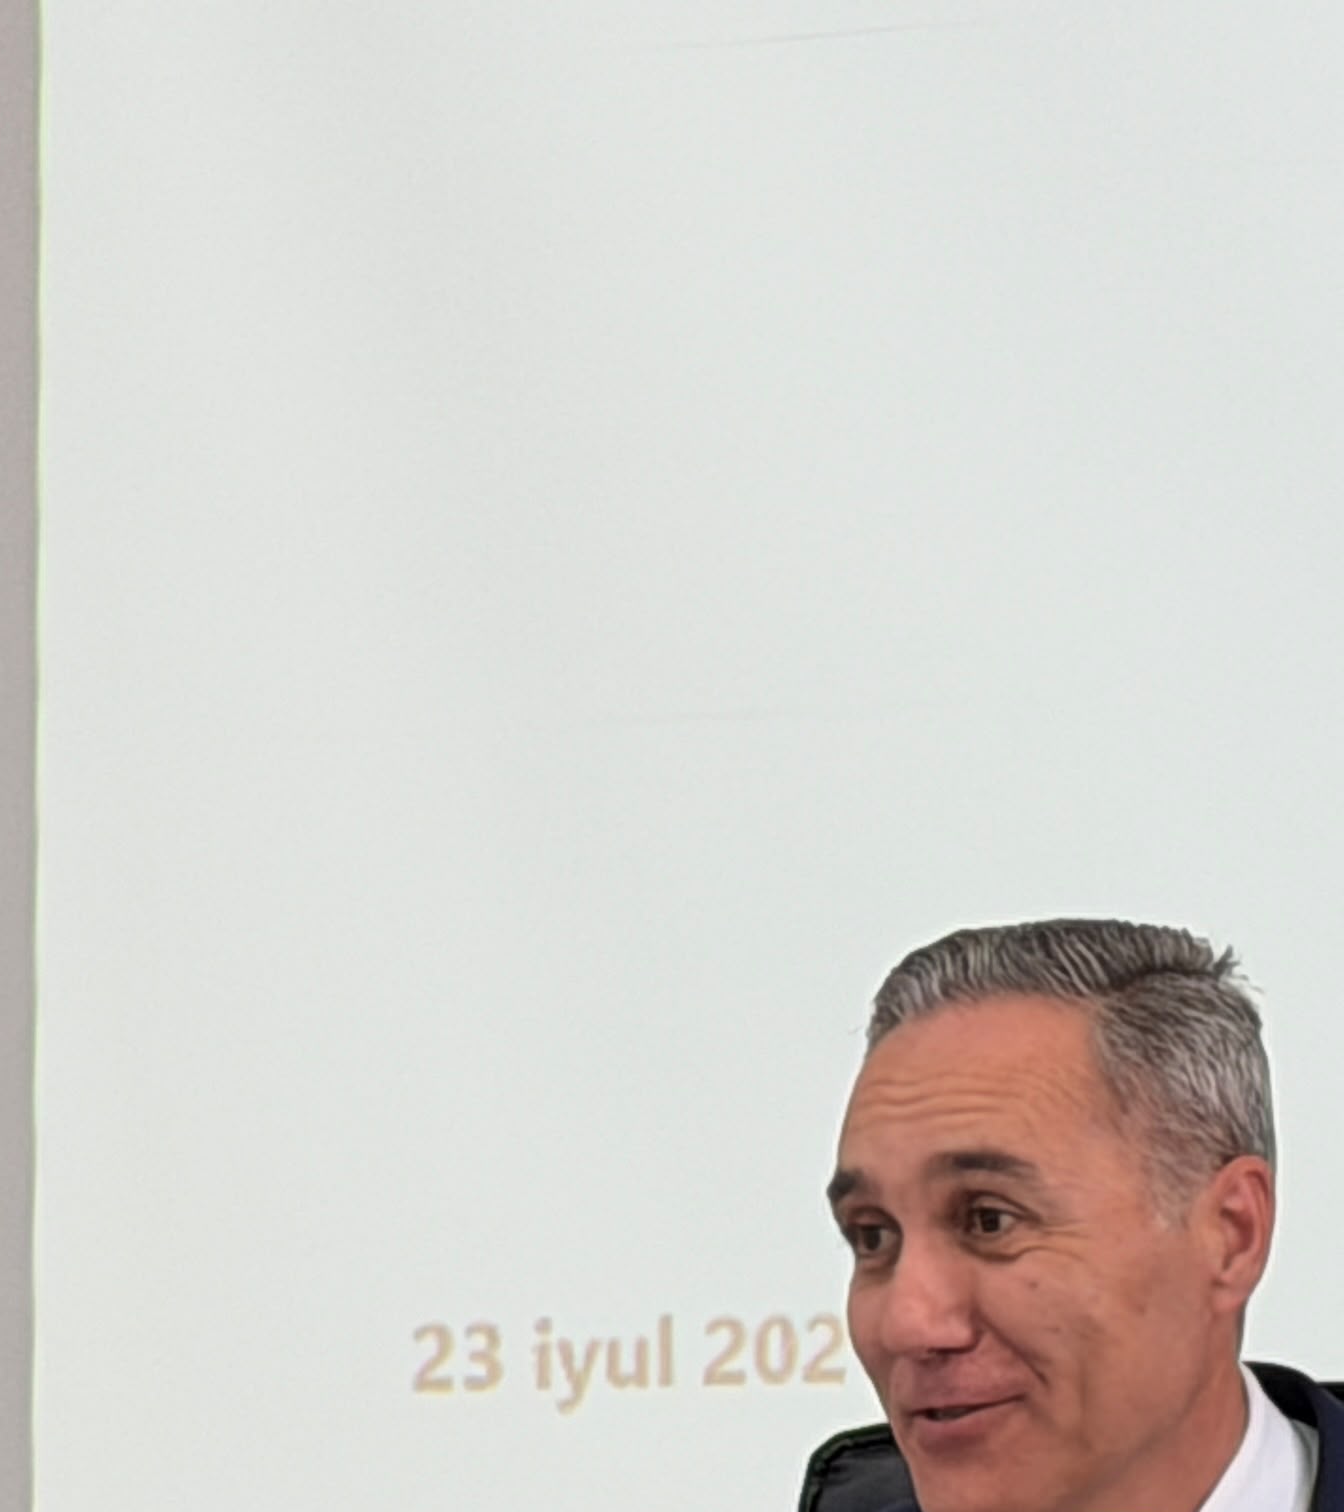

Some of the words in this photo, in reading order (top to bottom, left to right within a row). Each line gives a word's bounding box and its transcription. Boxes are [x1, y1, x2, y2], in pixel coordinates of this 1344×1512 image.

[412, 1322, 504, 1393] 23
[531, 1313, 675, 1414] iyul
[702, 1313, 847, 1386] 202
